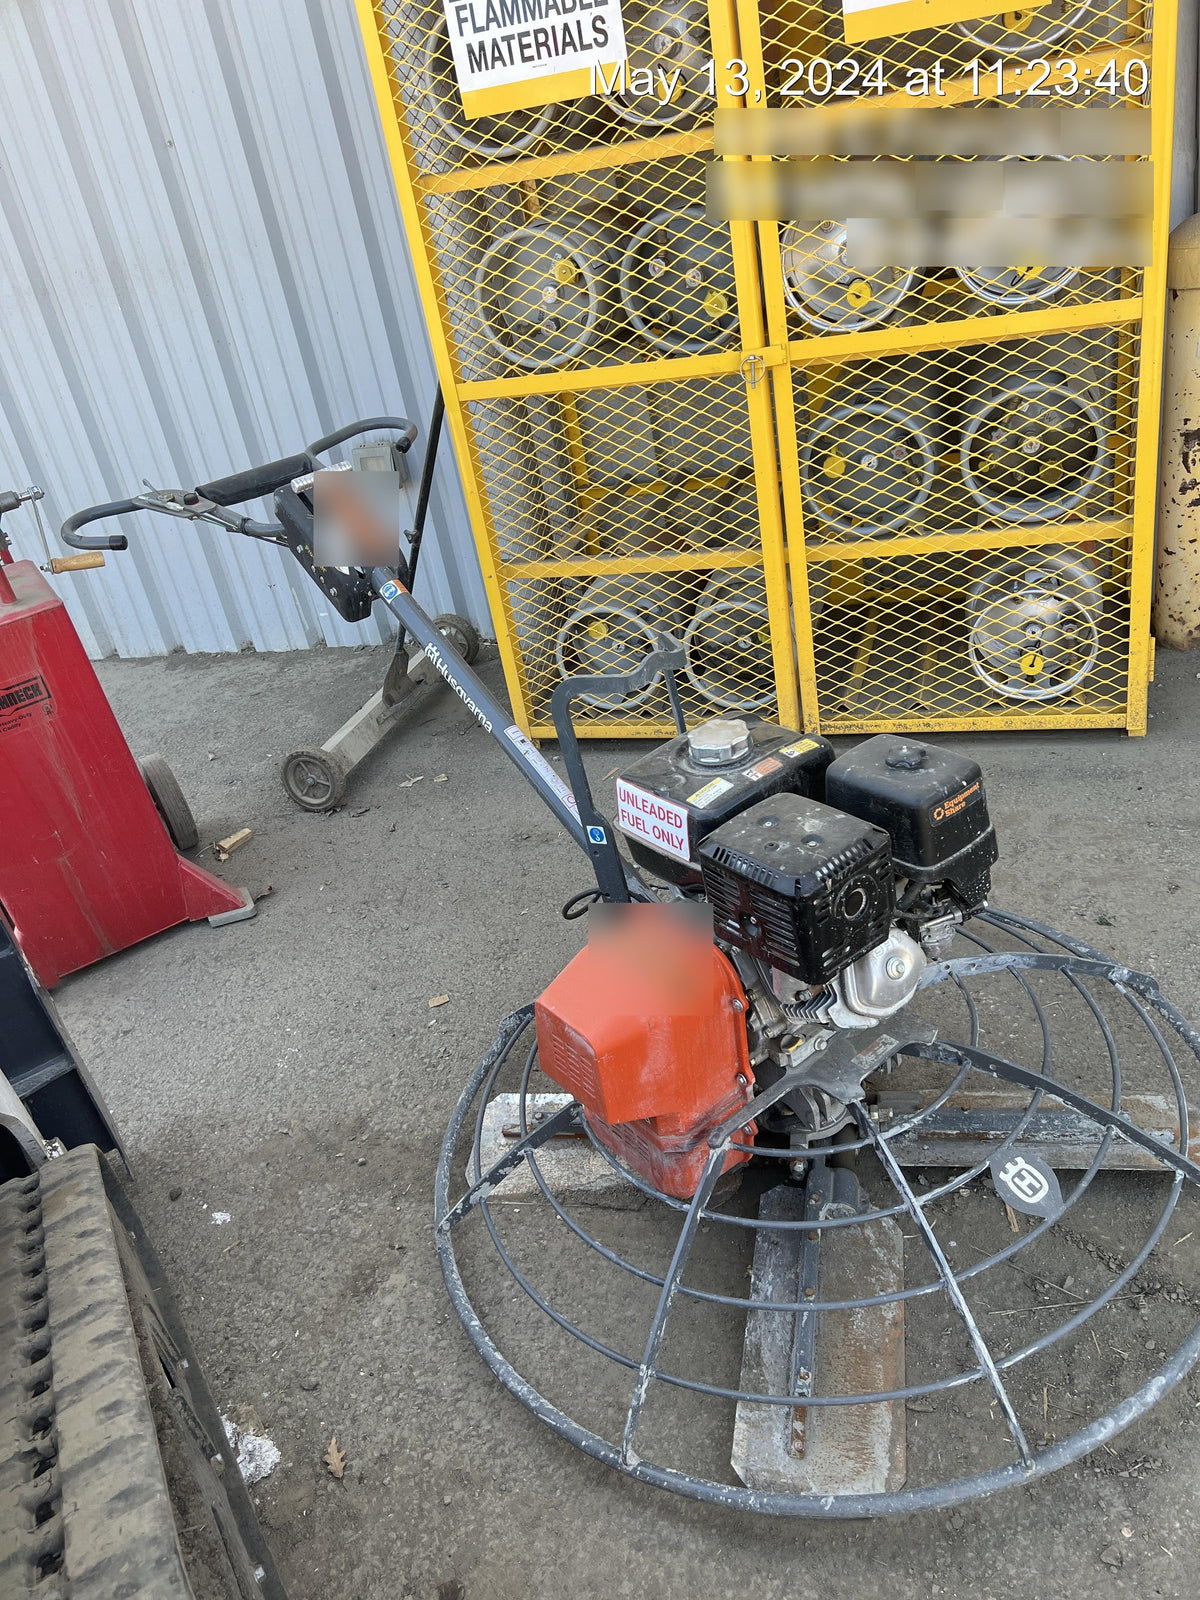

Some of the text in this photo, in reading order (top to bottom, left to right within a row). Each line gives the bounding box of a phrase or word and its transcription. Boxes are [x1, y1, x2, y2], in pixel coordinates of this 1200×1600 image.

[455, 0, 609, 37] FLAMMA
[466, 14, 609, 73] MATERIALS
[437, 658, 493, 733] Husqvarna
[619, 787, 683, 829] UNLEADED
[944, 782, 980, 810] Equipment
[945, 801, 966, 817] Share
[621, 808, 684, 851] FUEL ONLY
